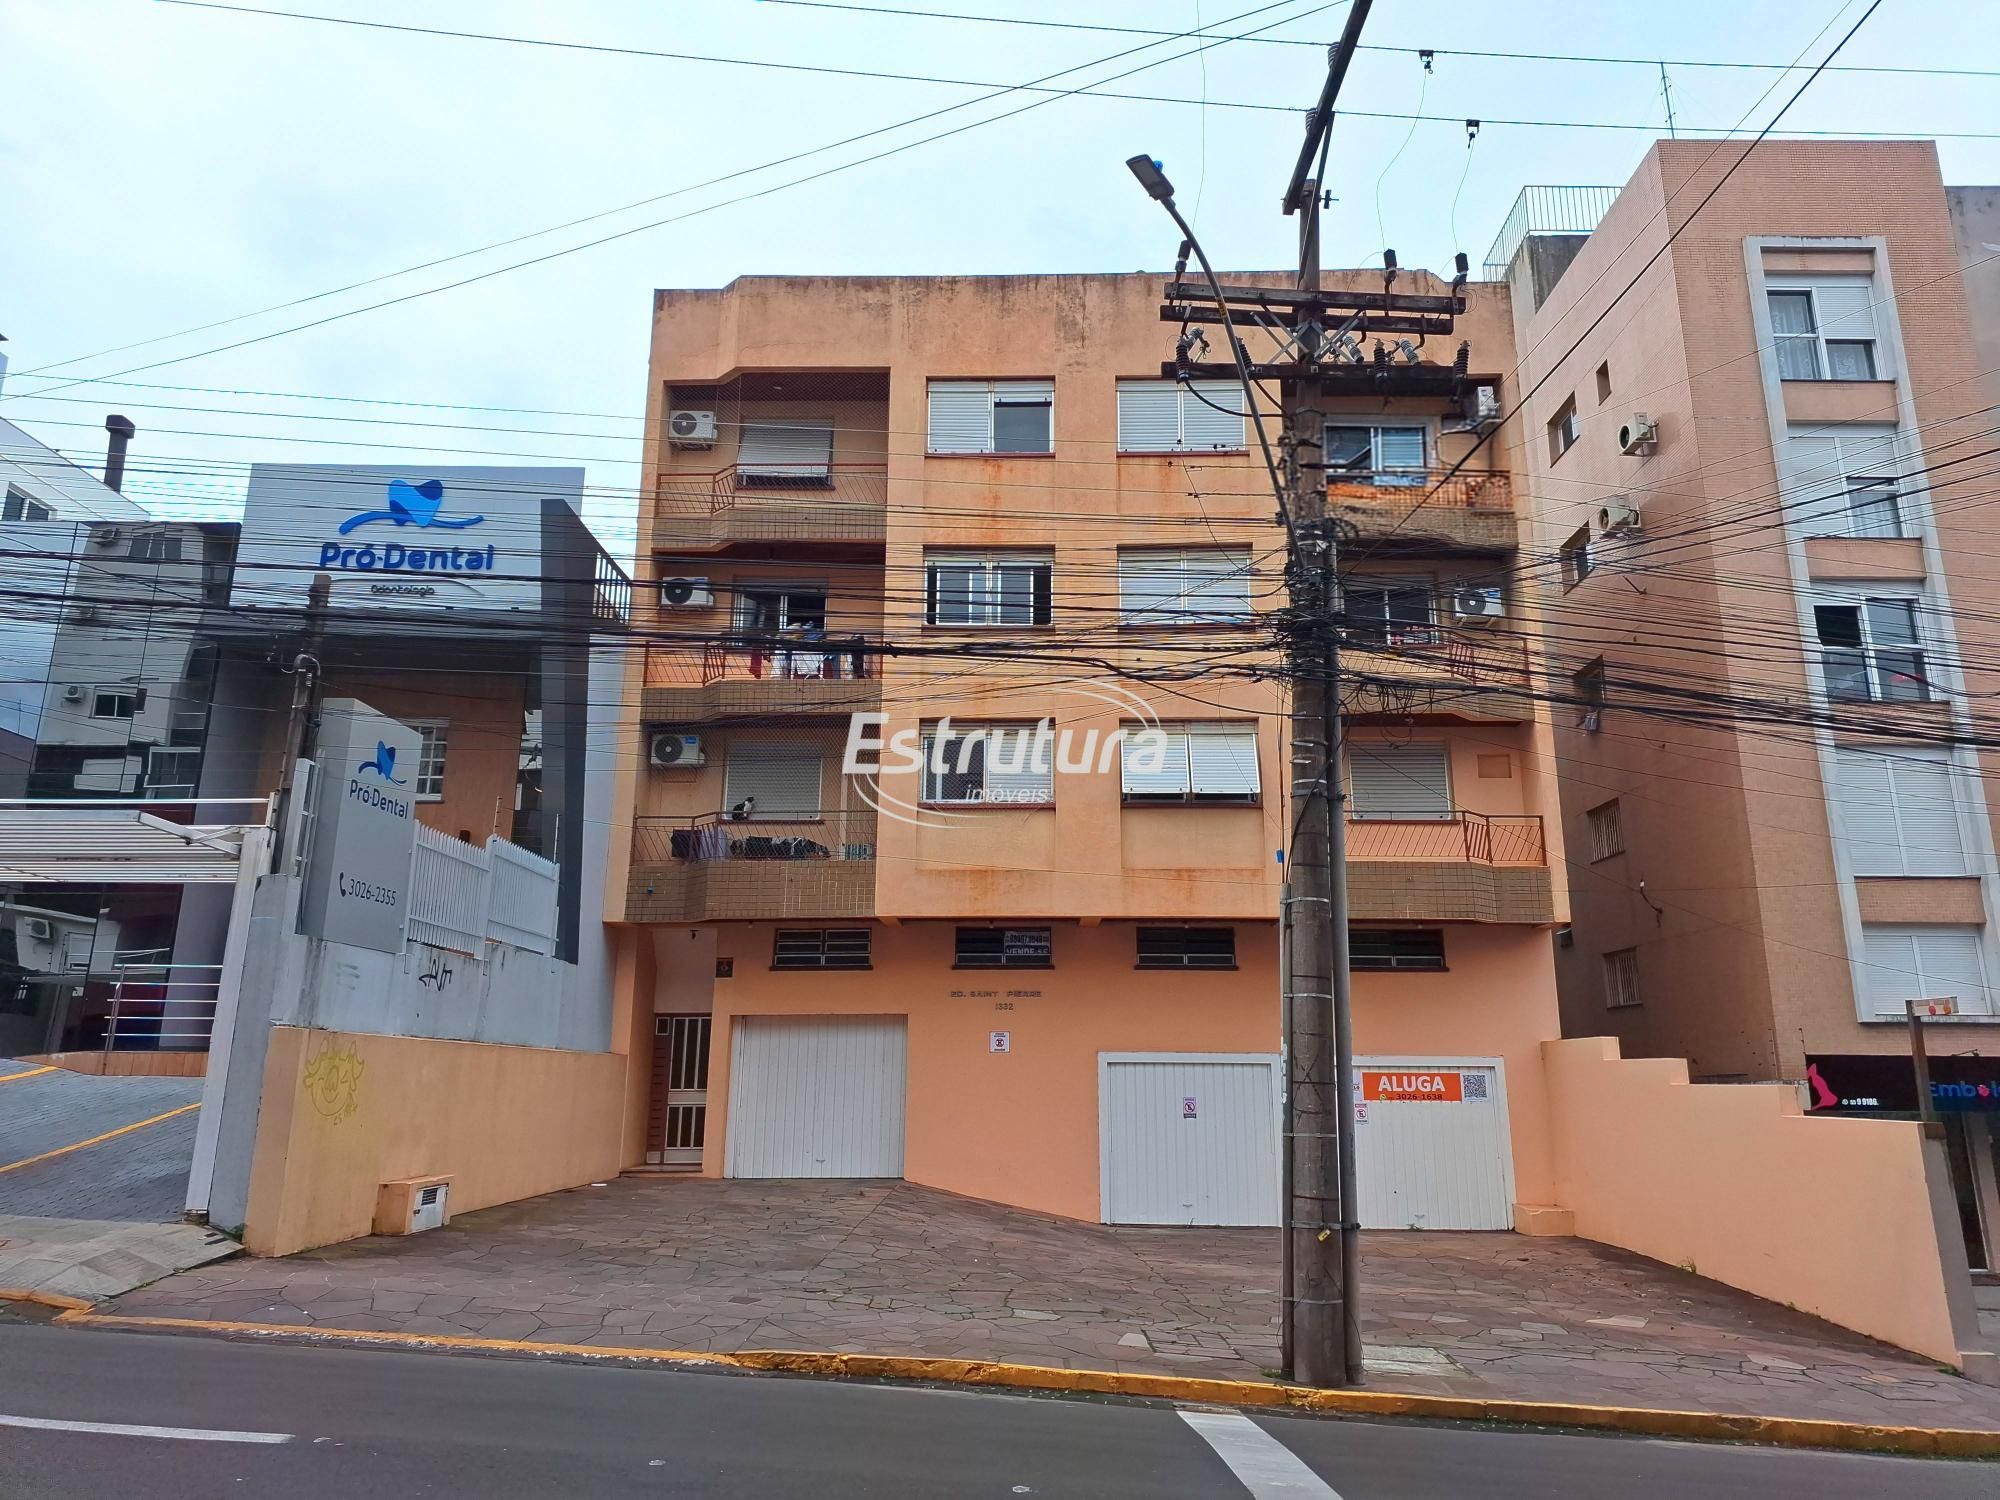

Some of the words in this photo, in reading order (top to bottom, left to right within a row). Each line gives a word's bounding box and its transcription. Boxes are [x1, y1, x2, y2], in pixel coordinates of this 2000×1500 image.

[349, 879, 396, 906] 3026-2355
[1378, 1075, 1446, 1092] ALUGA
[1396, 1093, 1443, 1101] 3026-1638
